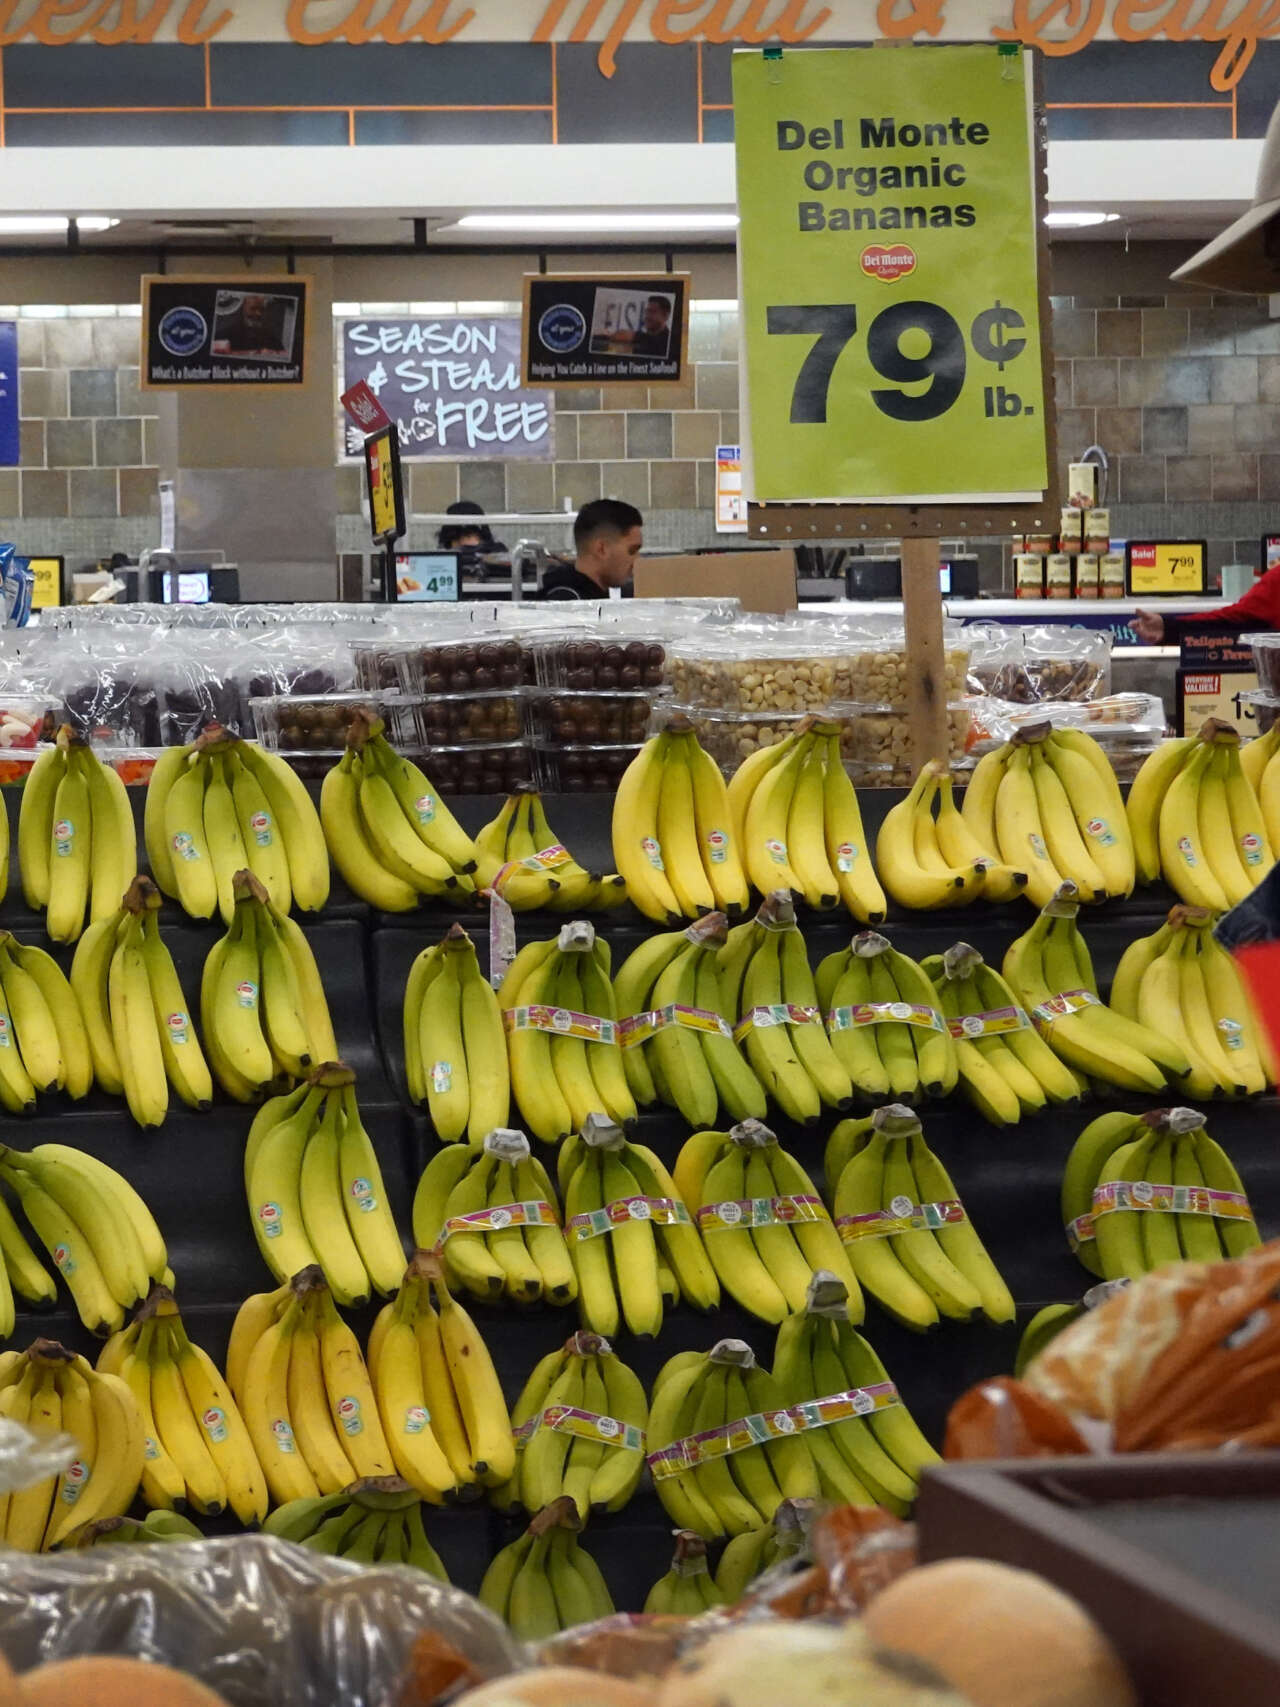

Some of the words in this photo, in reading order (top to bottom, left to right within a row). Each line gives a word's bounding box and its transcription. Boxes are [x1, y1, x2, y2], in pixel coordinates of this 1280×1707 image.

[777, 119, 844, 150] Del
[860, 117, 990, 148] Monte
[804, 157, 966, 196] Organic
[798, 202, 976, 231] Bananas
[348, 324, 497, 355] SEASON
[984, 386, 1034, 417] lb.
[436, 398, 548, 448] FREE
